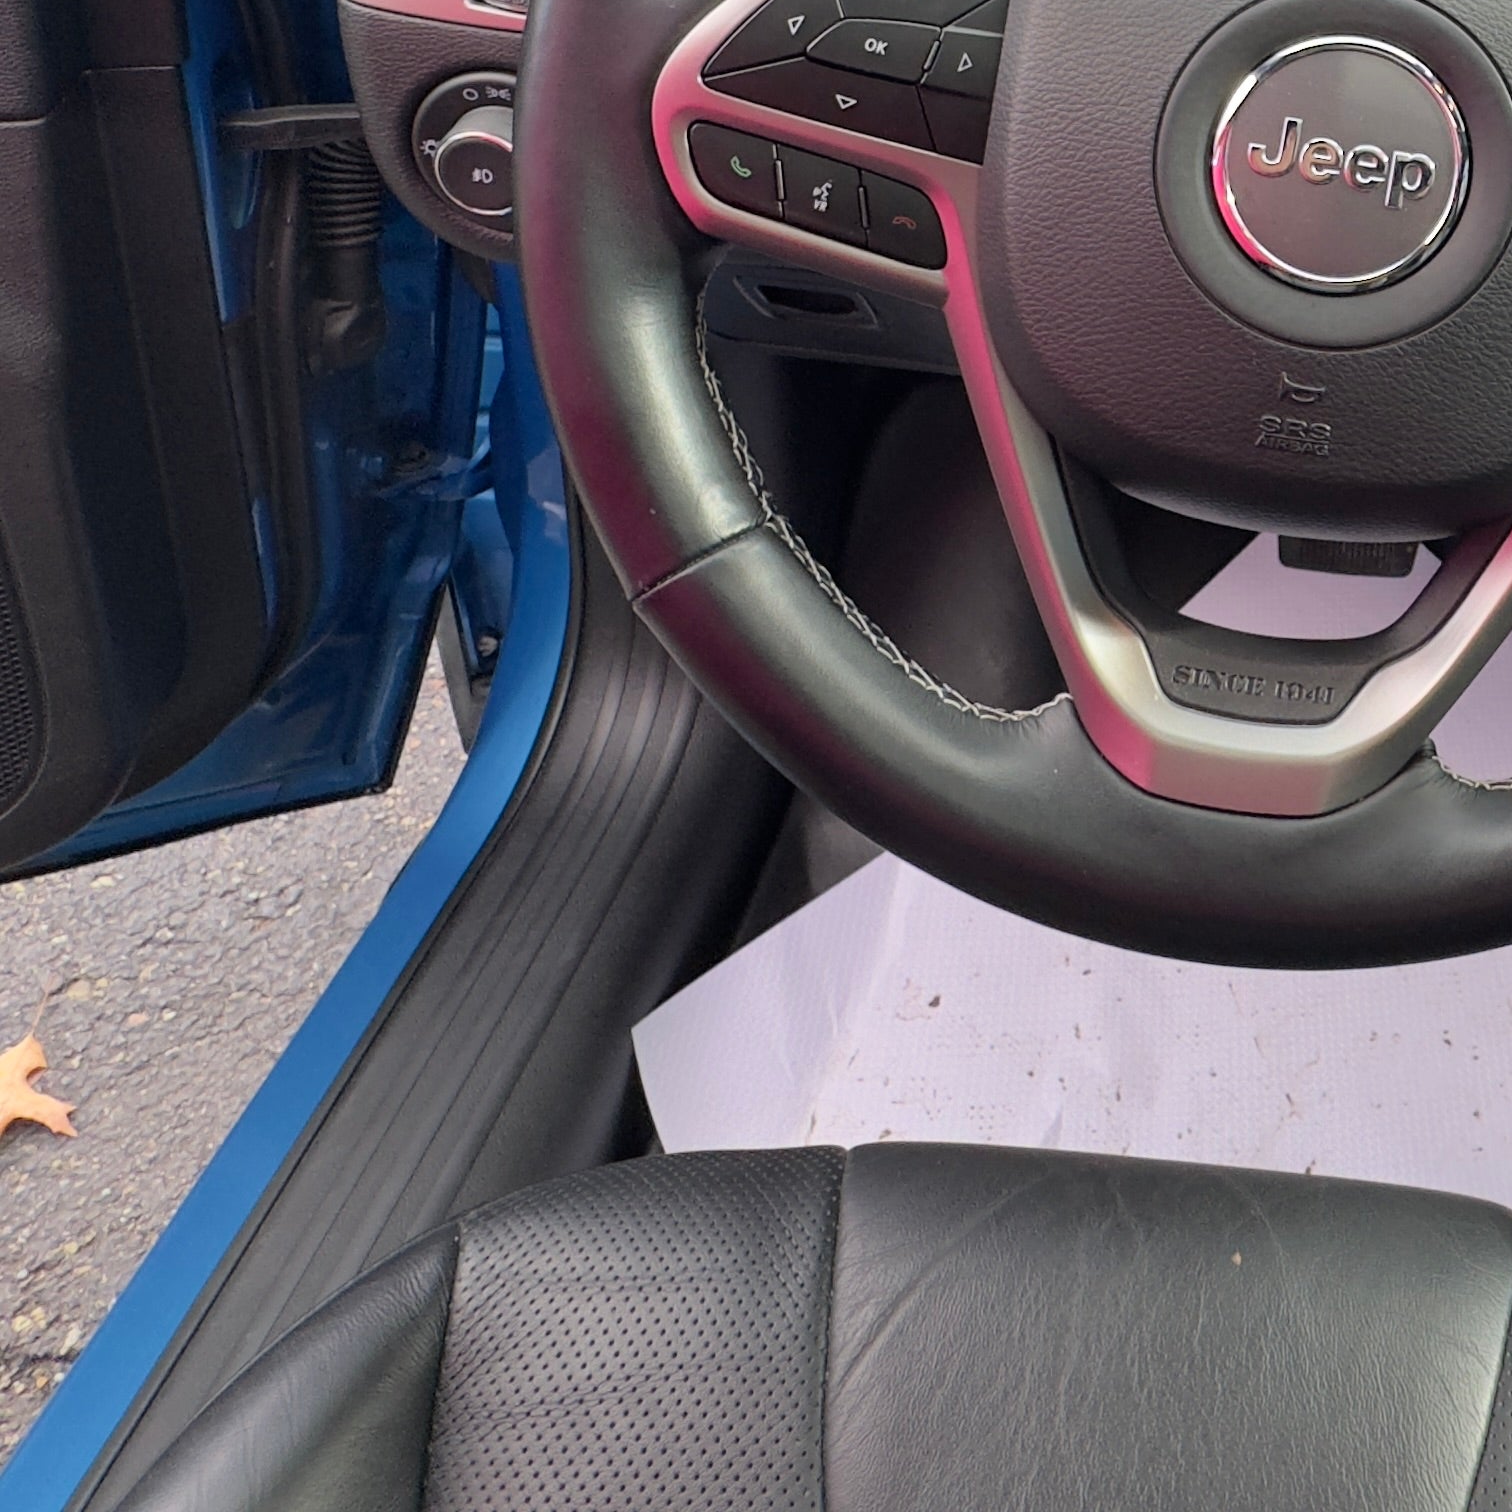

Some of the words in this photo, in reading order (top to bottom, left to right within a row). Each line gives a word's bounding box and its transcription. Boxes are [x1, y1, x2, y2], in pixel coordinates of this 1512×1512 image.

[864, 38, 888, 56] OK
[1247, 116, 1436, 209] Jeep
[813, 198, 829, 213] VR
[1259, 414, 1332, 439] SRS
[1254, 432, 1330, 457] AIRBAG
[1171, 664, 1267, 697] SINCE
[1274, 680, 1336, 706] 1941
